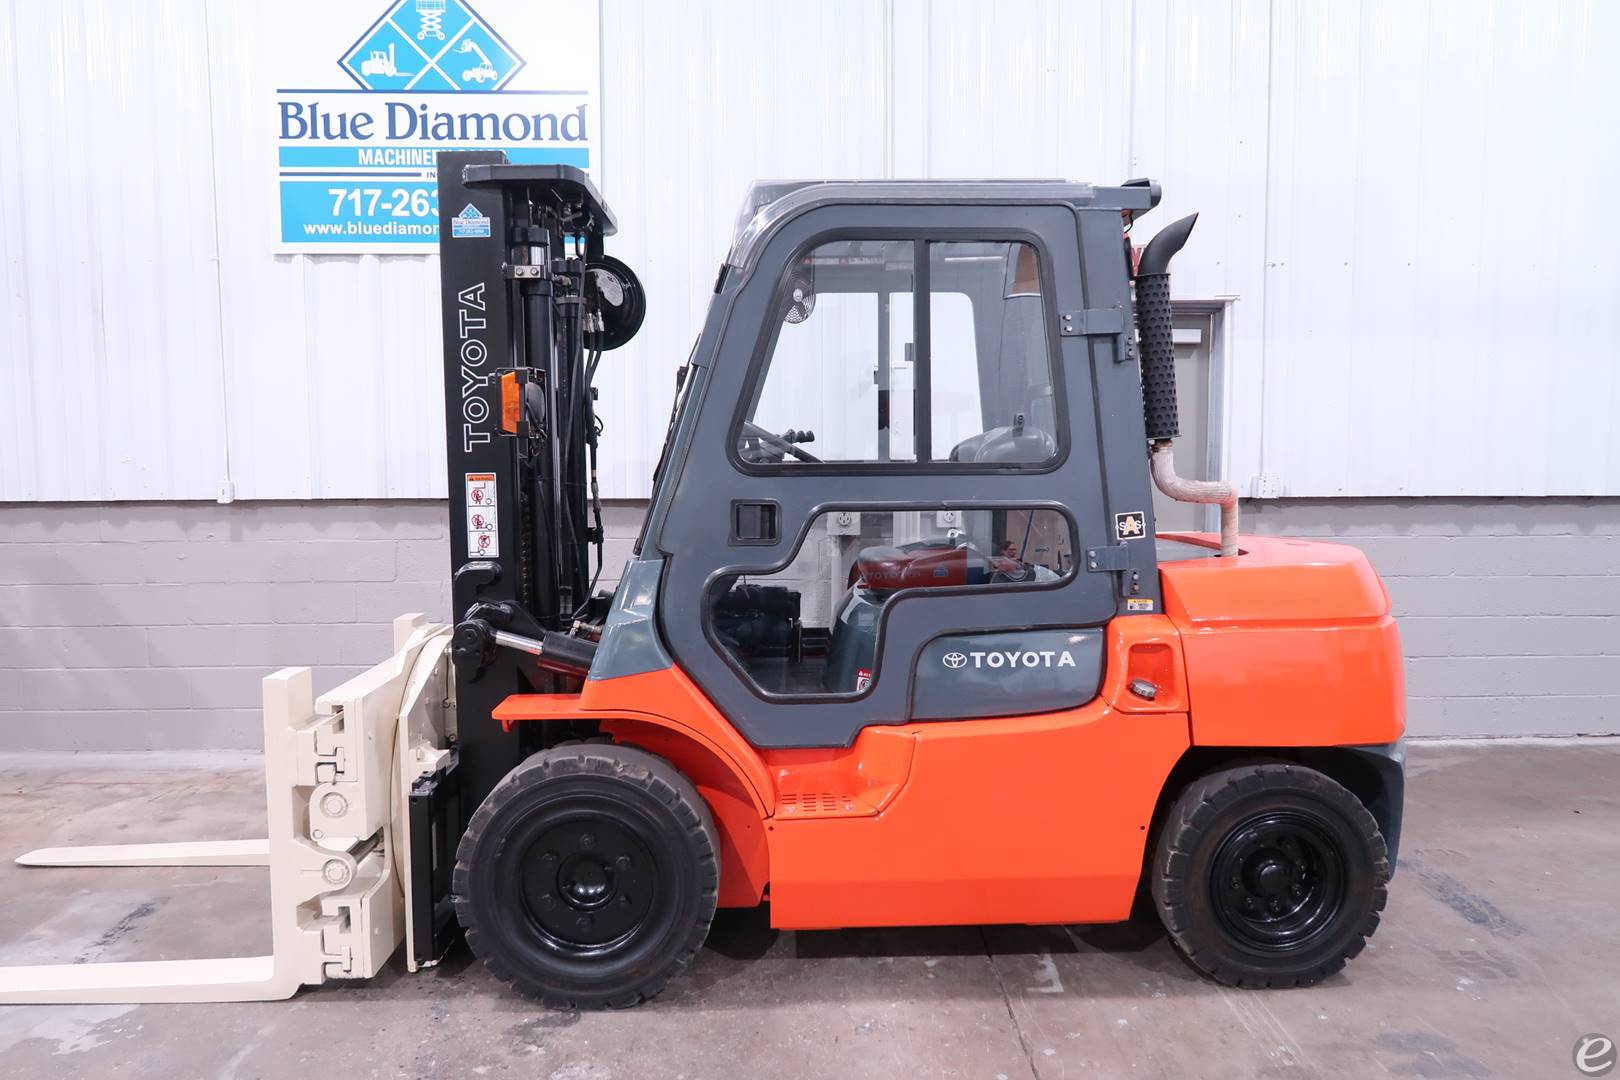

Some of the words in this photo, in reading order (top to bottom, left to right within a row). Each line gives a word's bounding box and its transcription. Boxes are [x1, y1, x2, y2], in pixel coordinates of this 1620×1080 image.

[278, 102, 374, 140] Blue
[385, 102, 588, 141] Diamond
[458, 282, 490, 453] TOYOTA
[969, 651, 1076, 668] TOYOTA
